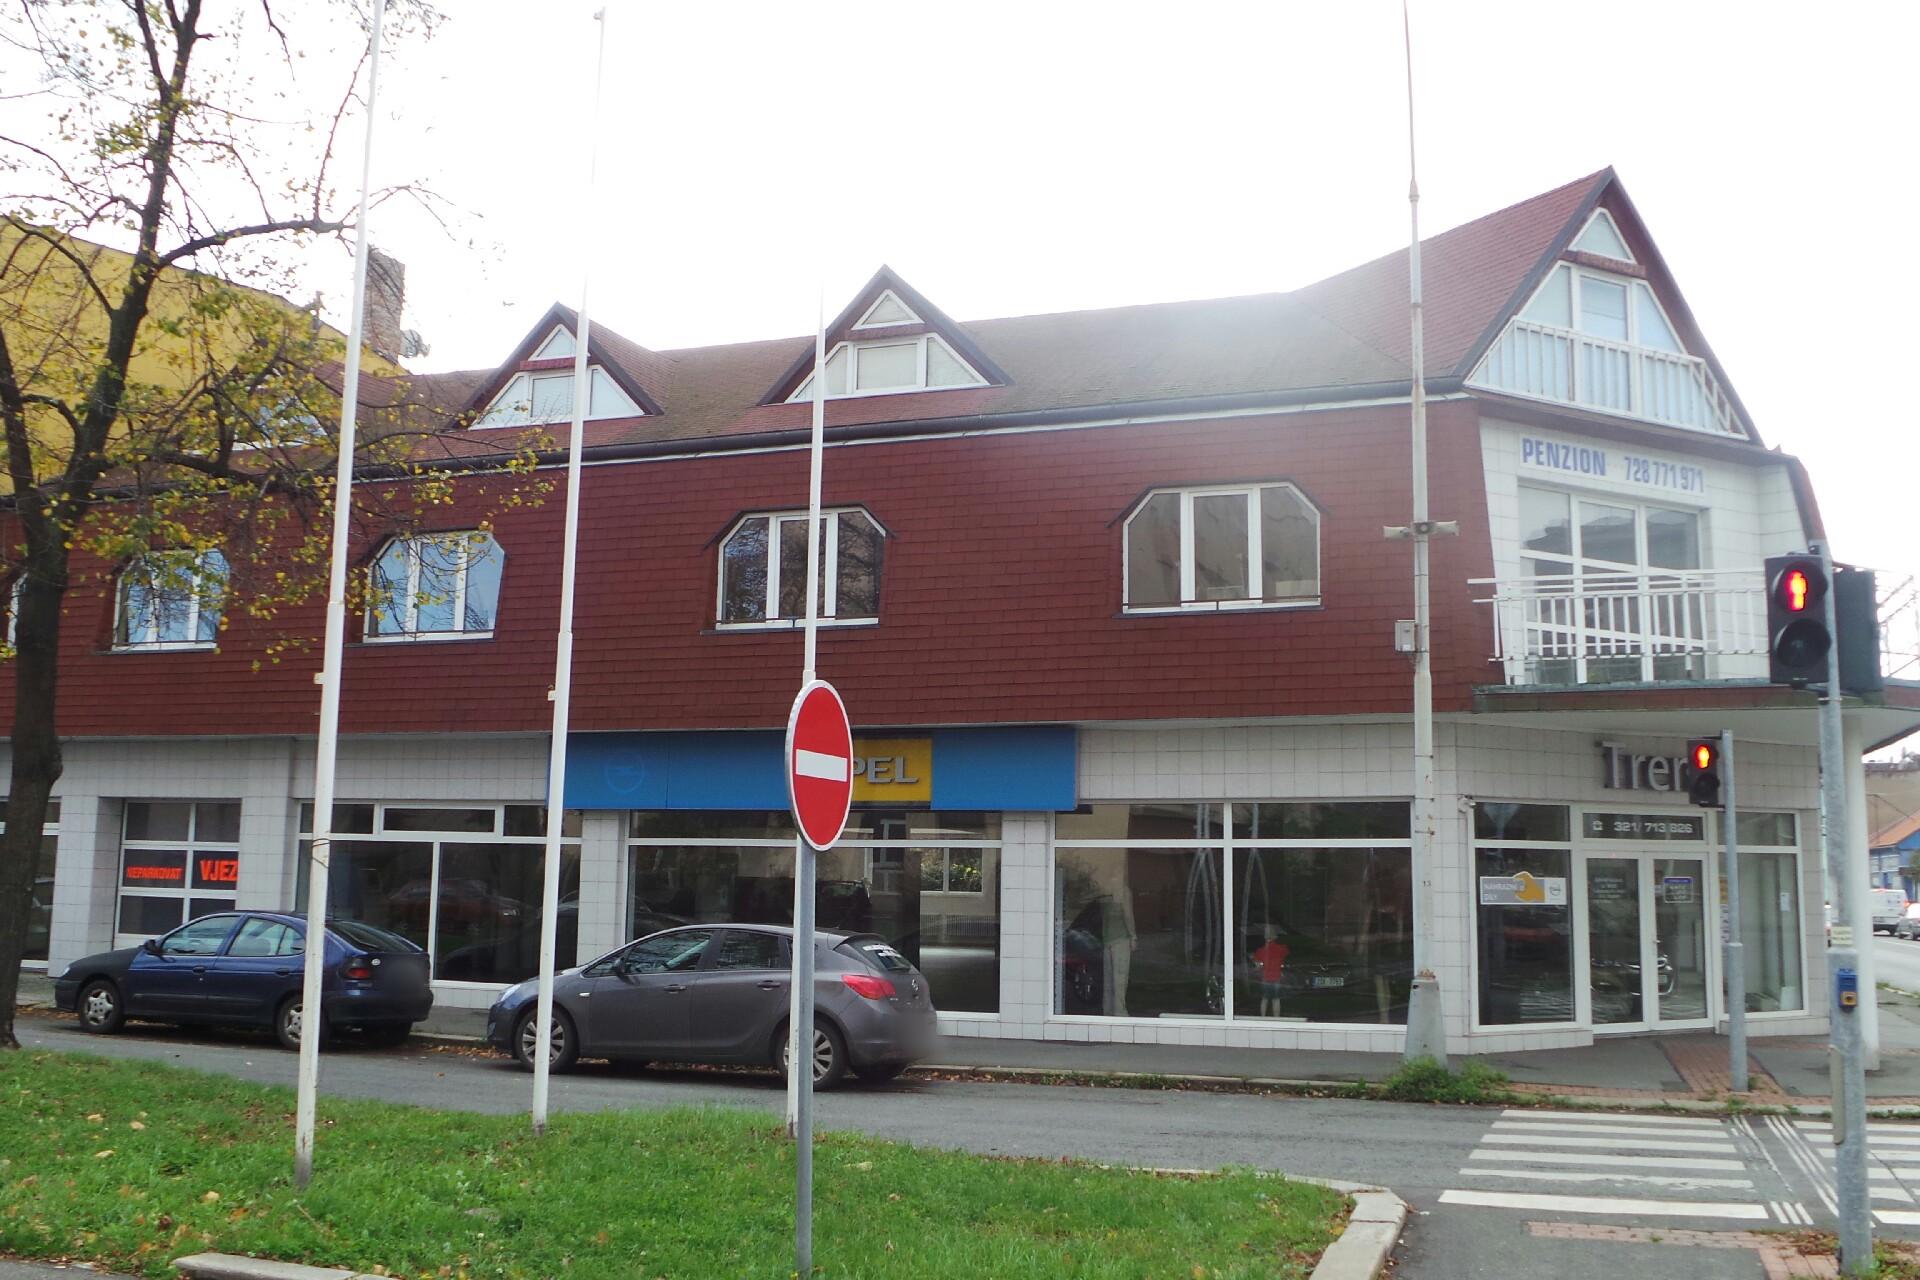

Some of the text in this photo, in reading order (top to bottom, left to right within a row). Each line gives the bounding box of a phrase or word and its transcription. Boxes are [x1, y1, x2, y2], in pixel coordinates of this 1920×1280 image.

[1522, 438, 1705, 493] PENZION 728 771 971
[853, 756, 920, 783] PEL
